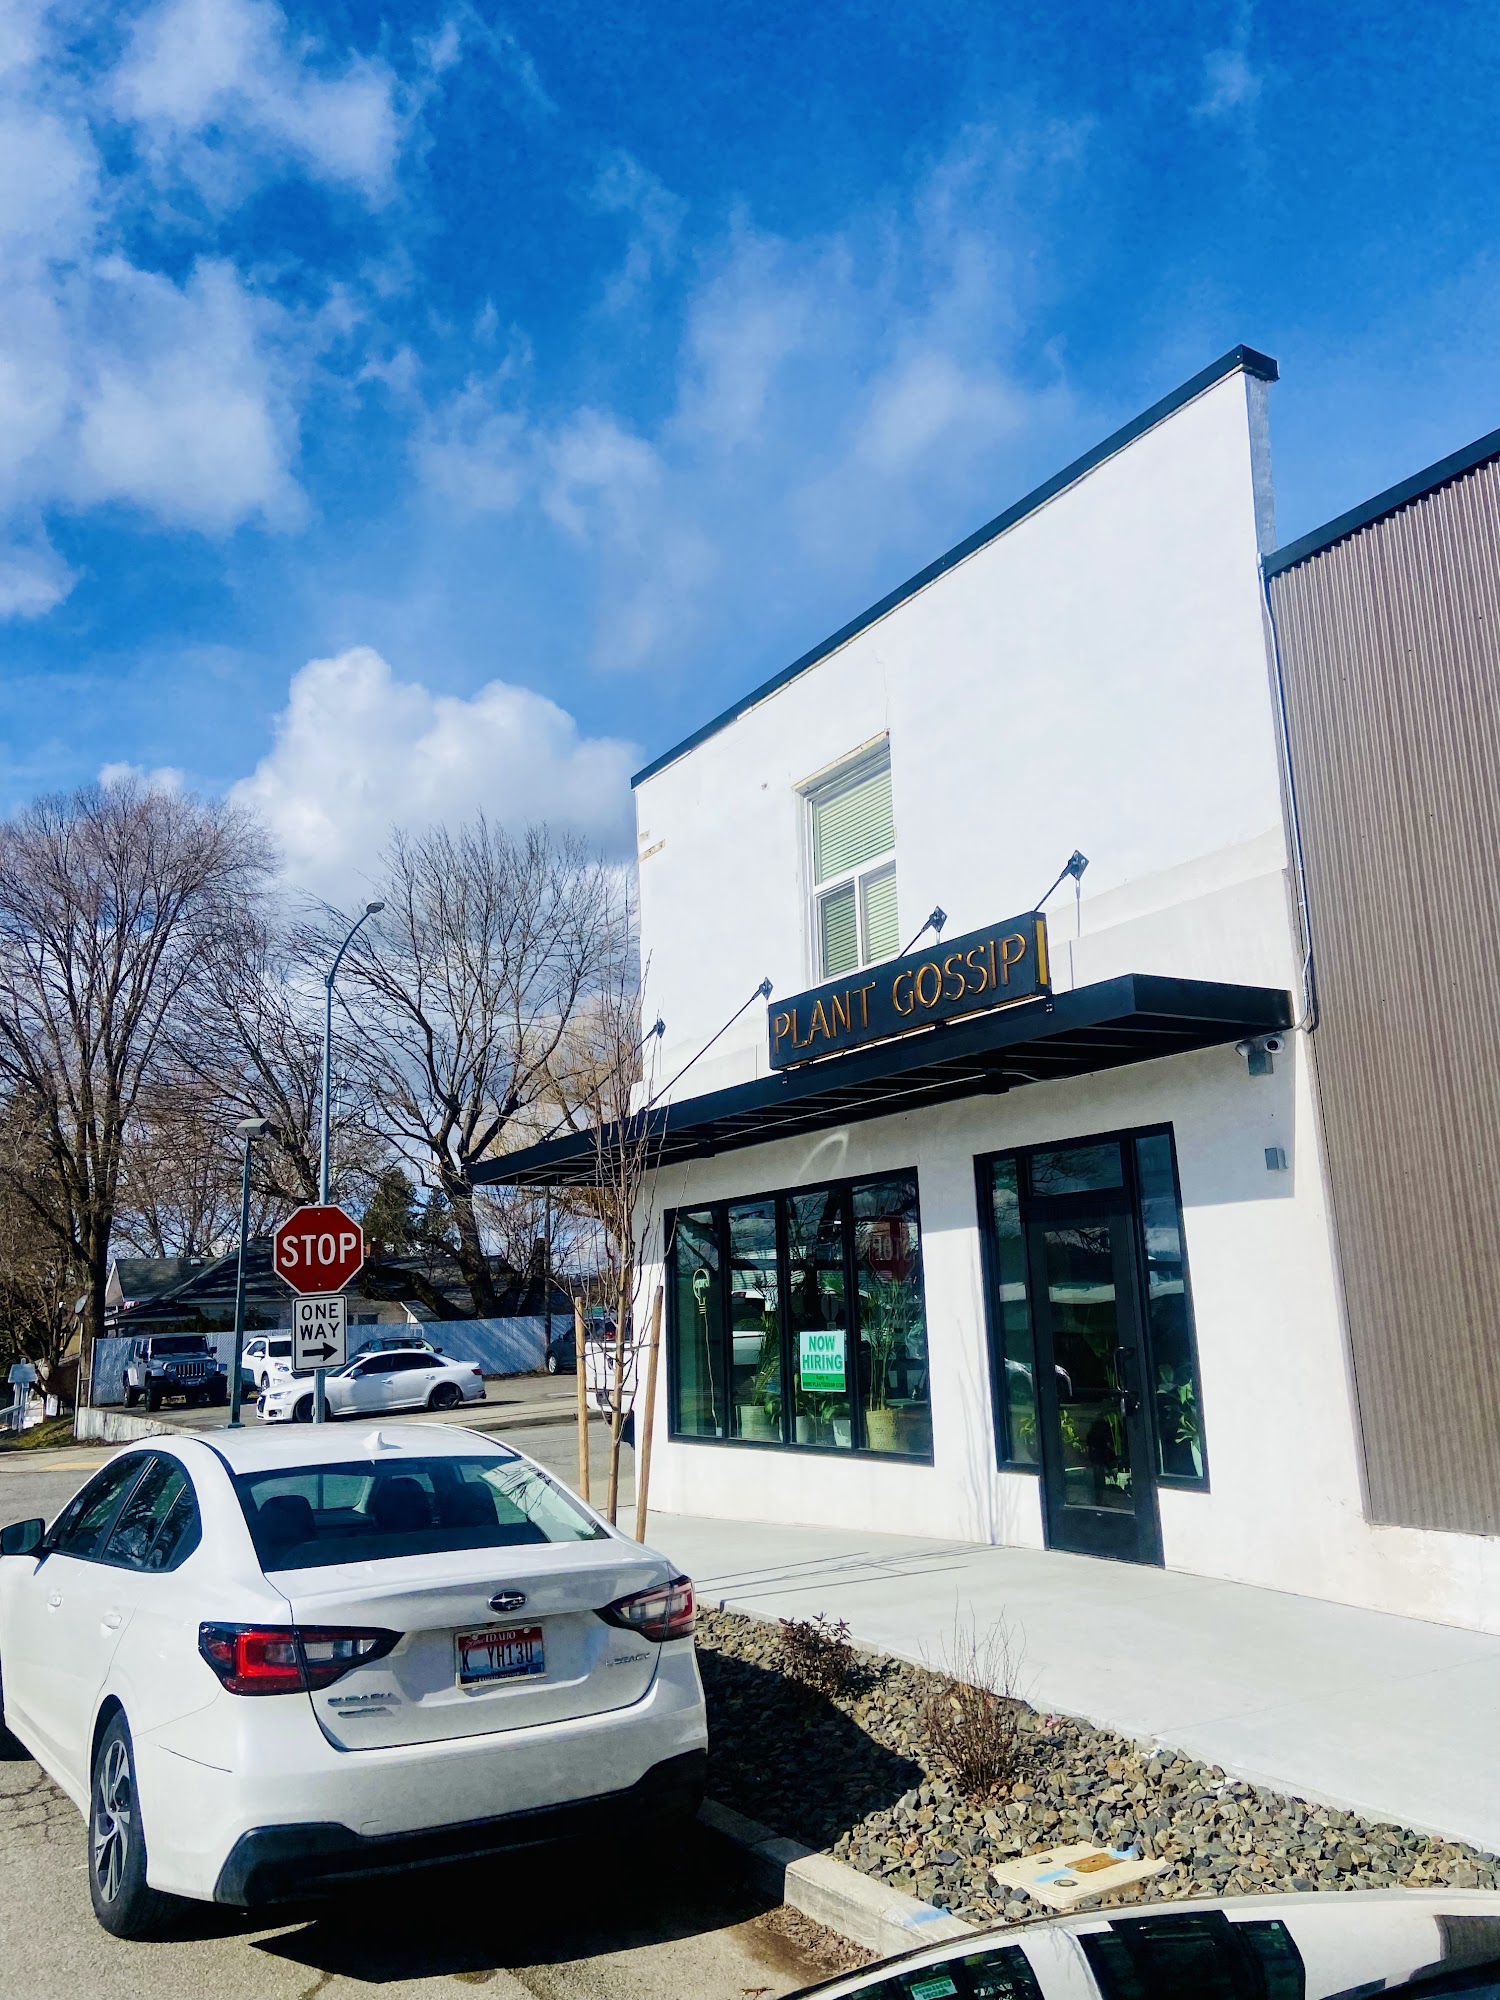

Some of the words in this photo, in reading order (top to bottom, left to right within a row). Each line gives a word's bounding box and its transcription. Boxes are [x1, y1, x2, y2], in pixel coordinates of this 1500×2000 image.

[774, 981, 876, 1054] PLANT
[892, 933, 1027, 1017] GOSSIP
[280, 1232, 357, 1267] STOP
[301, 1302, 339, 1321] ONE
[300, 1322, 341, 1341] WAY
[808, 1335, 836, 1352] NOW
[802, 1354, 844, 1371] HIRING
[485, 1630, 516, 1643] IDAHO
